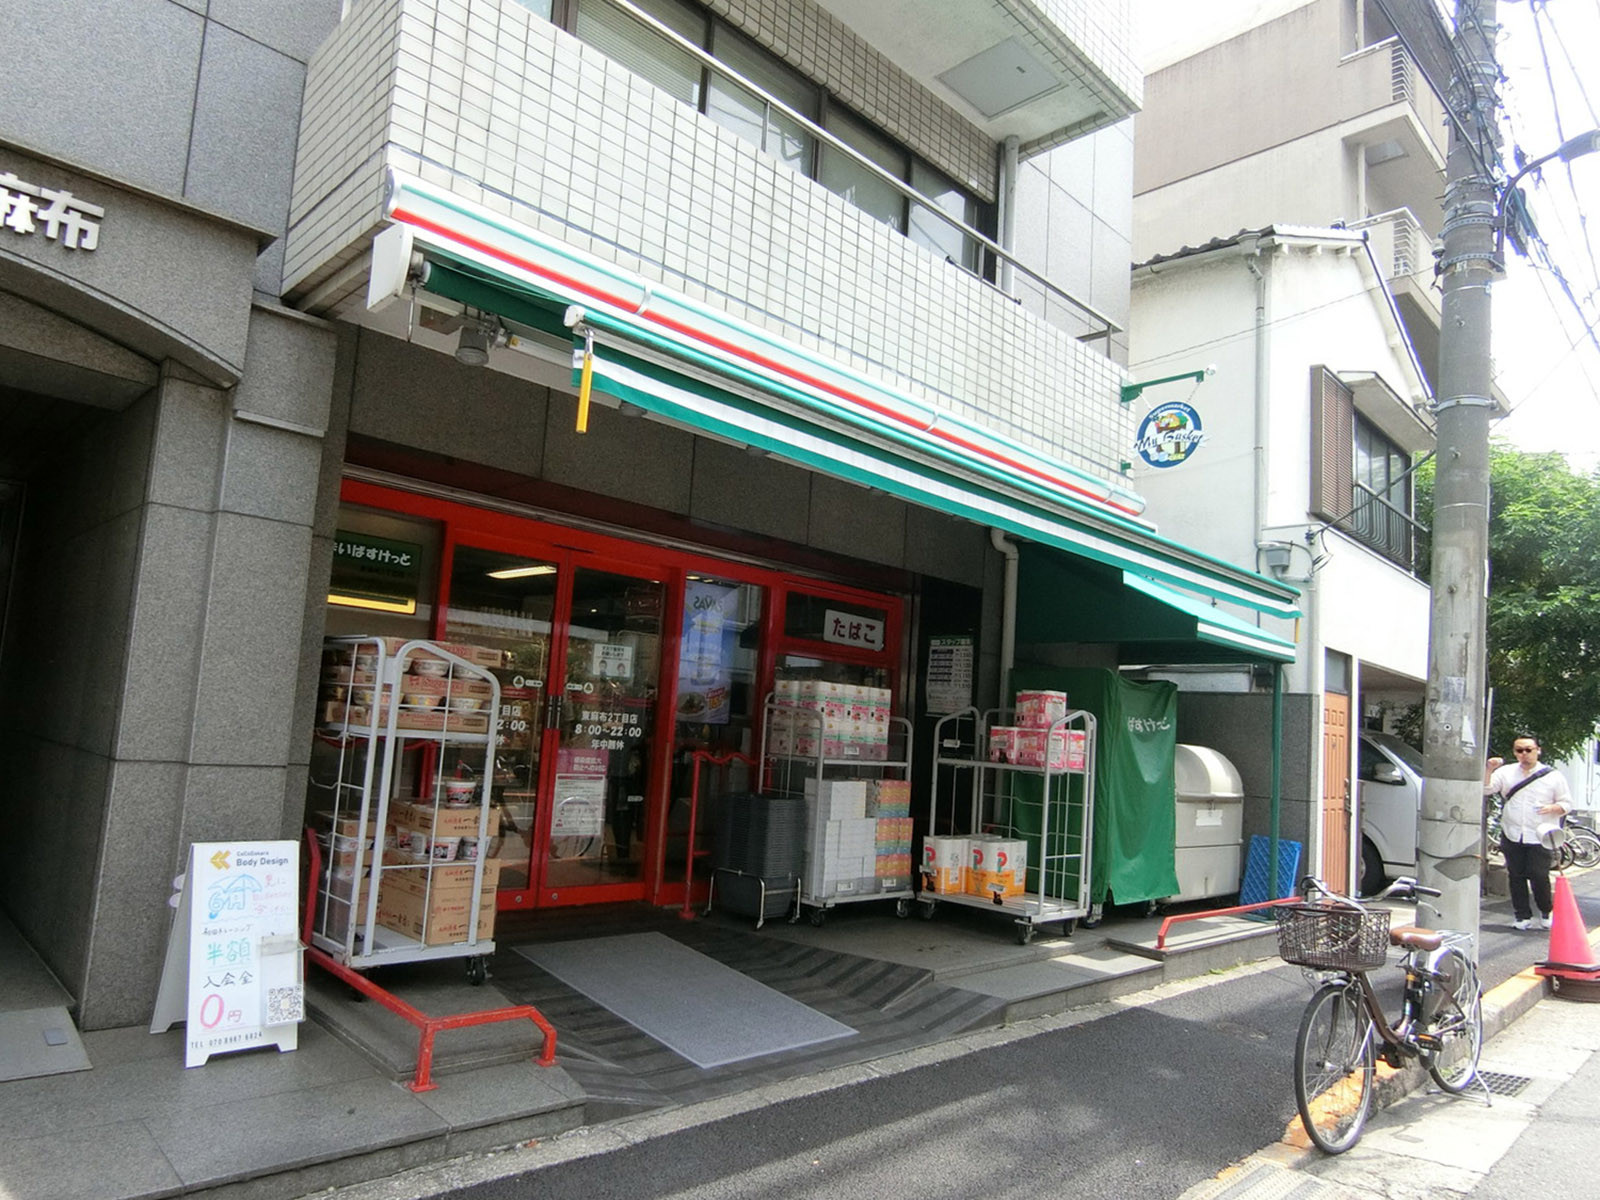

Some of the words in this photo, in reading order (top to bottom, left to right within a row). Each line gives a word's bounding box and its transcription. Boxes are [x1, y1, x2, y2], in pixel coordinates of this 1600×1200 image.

[1133, 436, 1158, 451] My
[1163, 429, 1203, 443] Basket
[832, 617, 876, 644] たばこ
[581, 710, 639, 724] 東麻布2丁目店
[591, 739, 625, 751] 年中無休
[236, 858, 257, 868] Body
[260, 856, 289, 867] Design
[207, 937, 252, 966] 半額
[203, 970, 254, 989] 入会金
[190, 1041, 204, 1049] TEL
